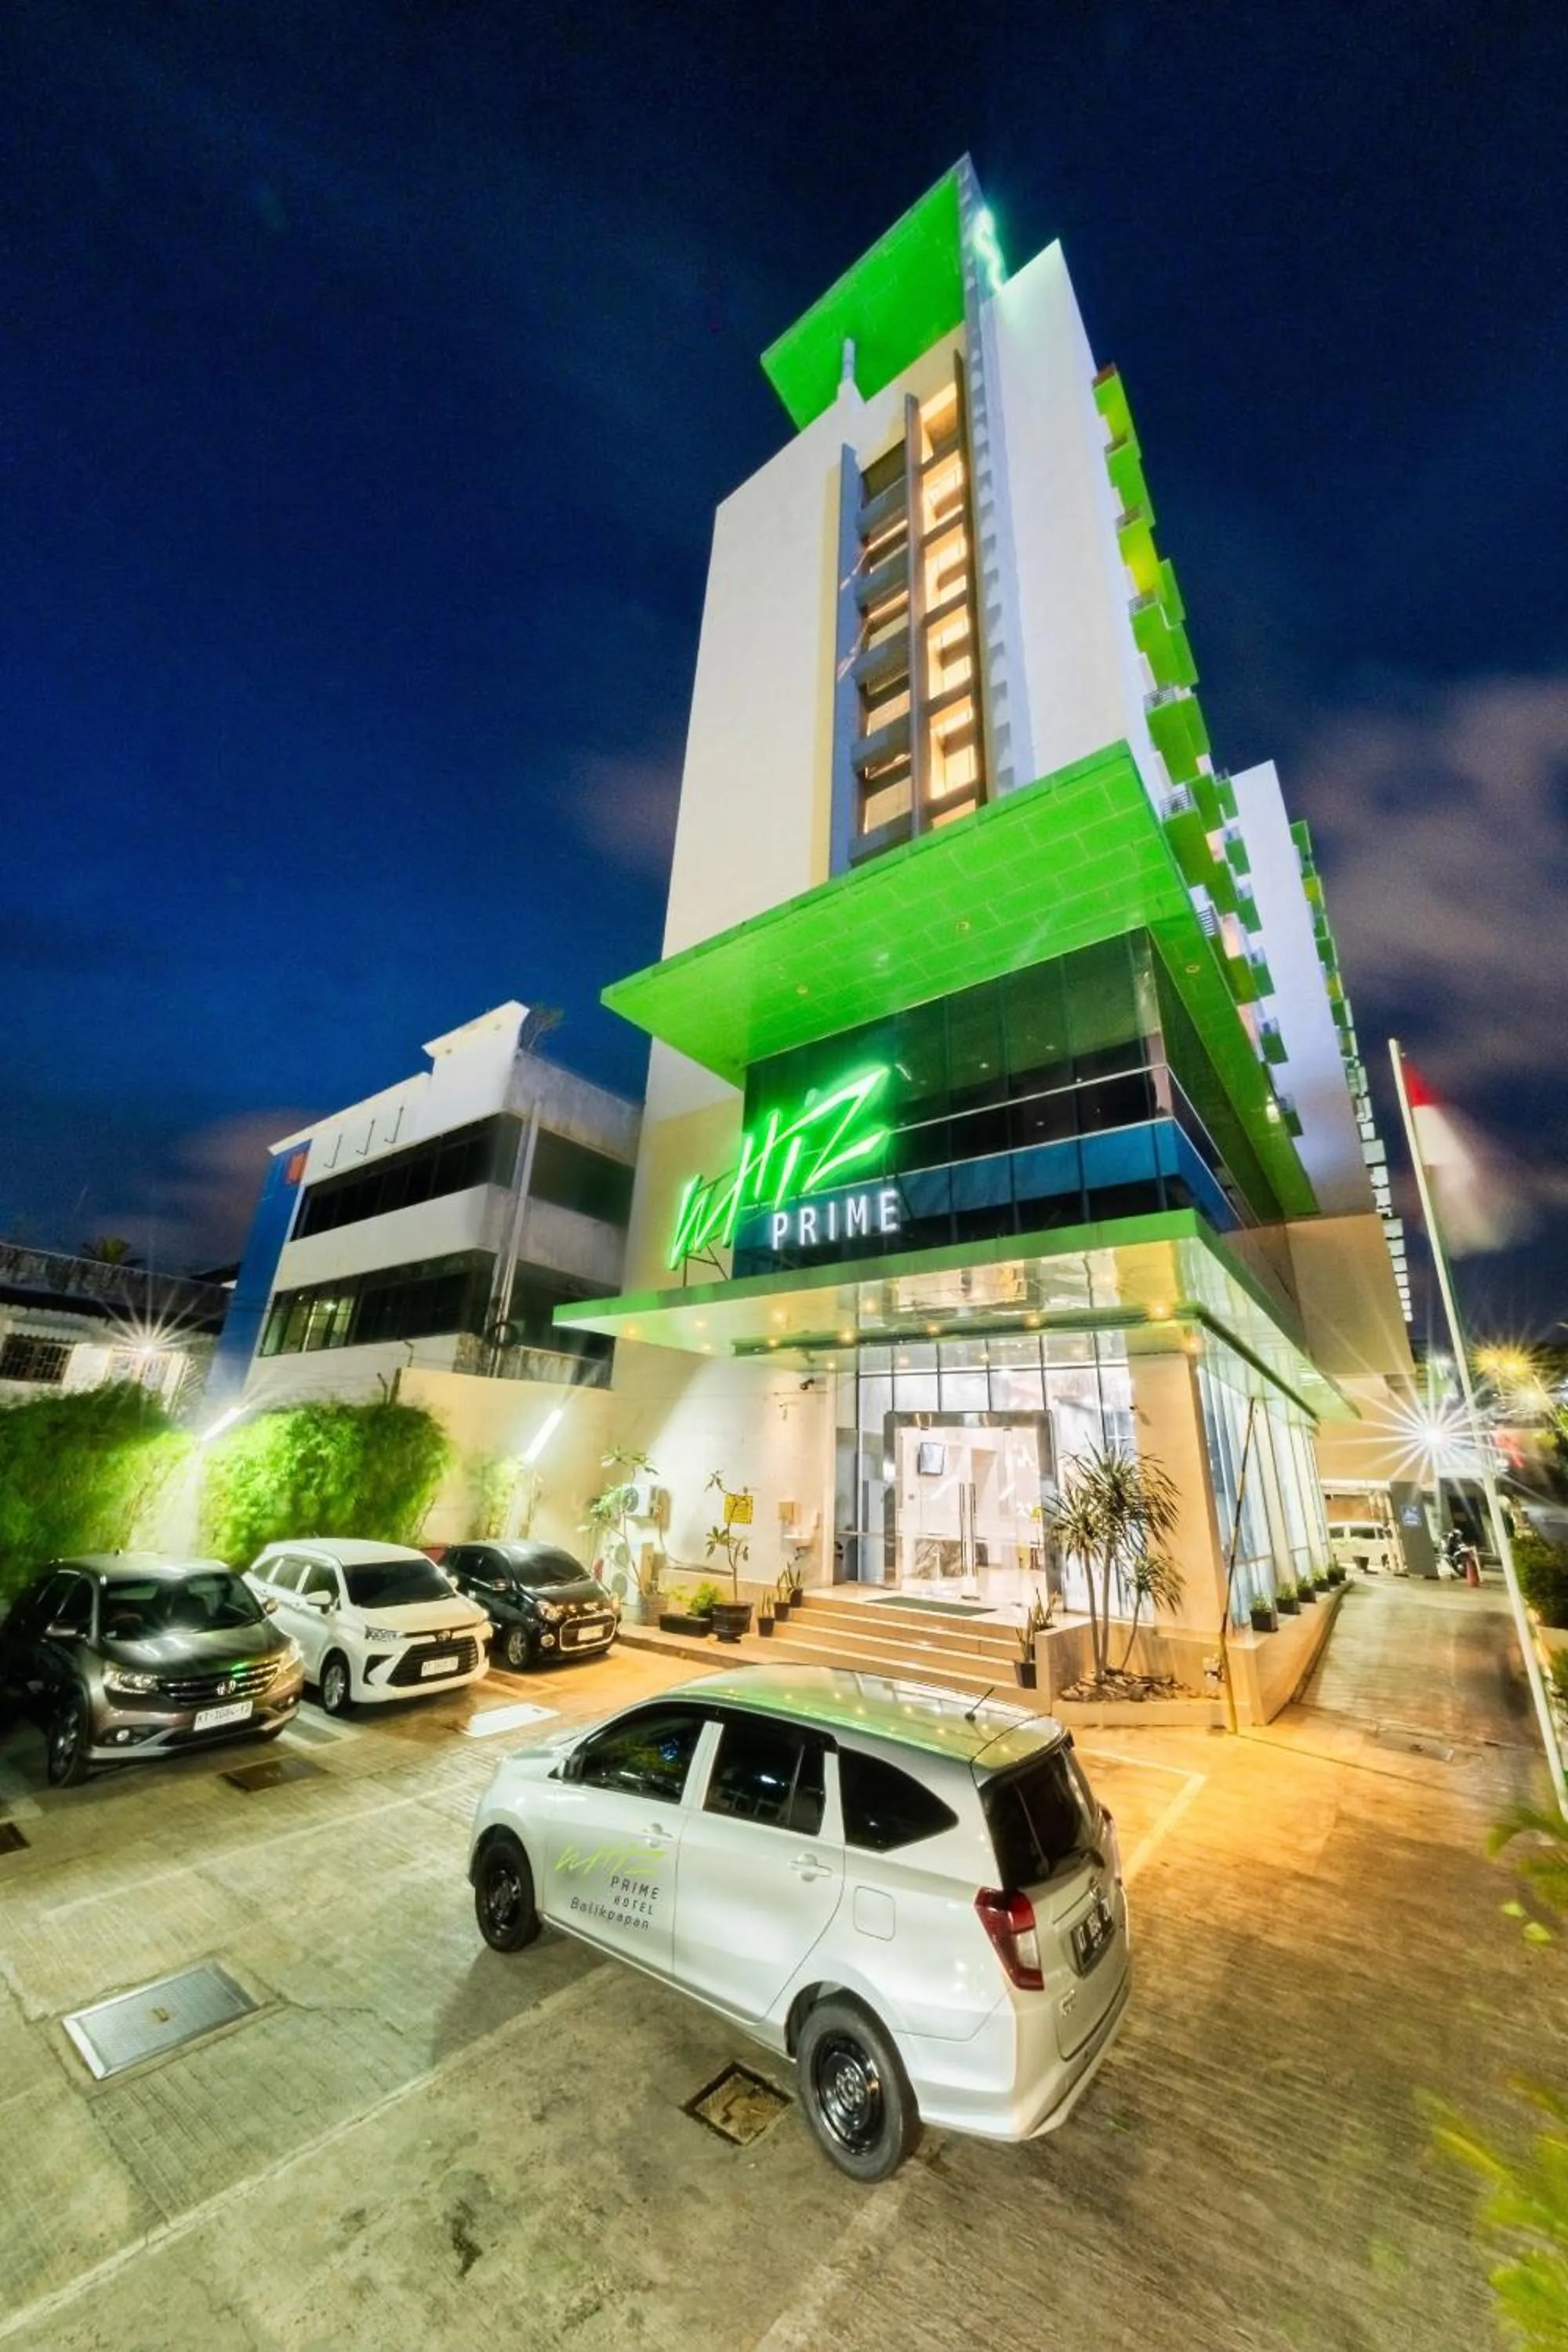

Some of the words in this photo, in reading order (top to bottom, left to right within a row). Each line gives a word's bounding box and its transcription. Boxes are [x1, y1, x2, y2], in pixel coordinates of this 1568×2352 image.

[772, 1190, 900, 1250] PRIME
[611, 1875, 659, 1900] PRIME
[614, 1896, 653, 1915] HOTEL
